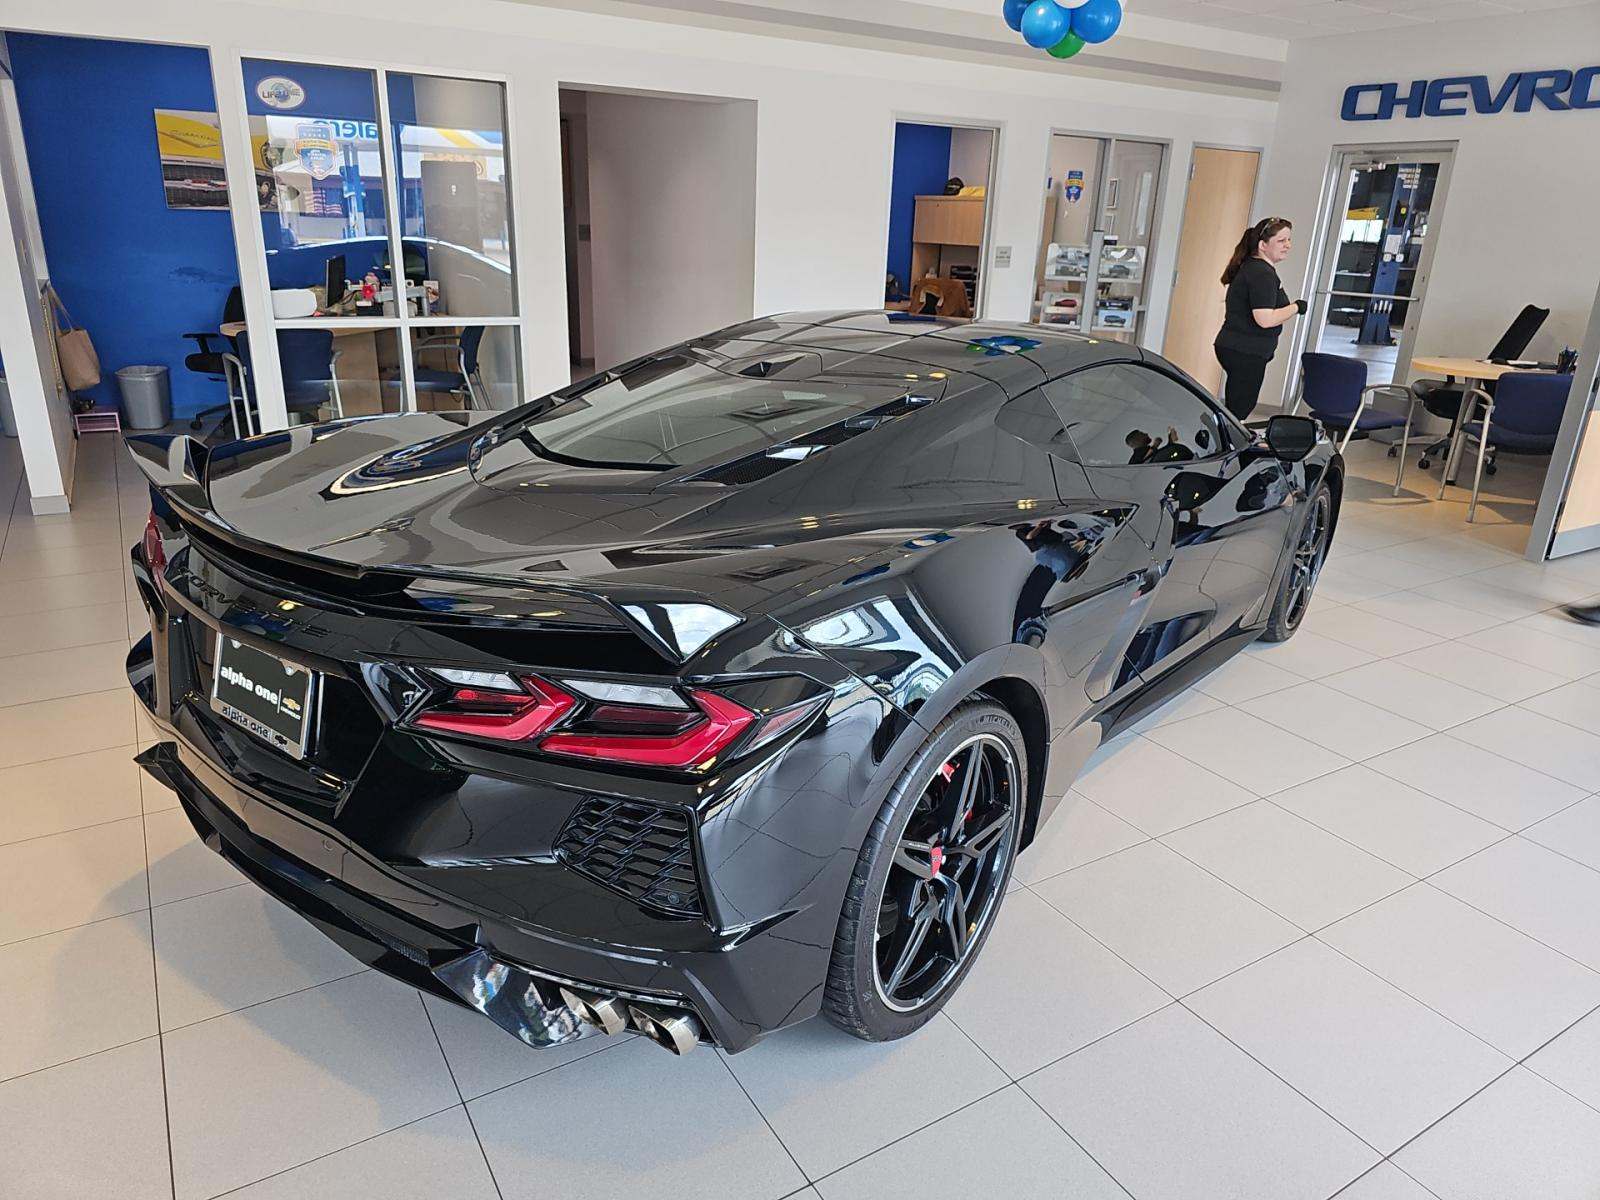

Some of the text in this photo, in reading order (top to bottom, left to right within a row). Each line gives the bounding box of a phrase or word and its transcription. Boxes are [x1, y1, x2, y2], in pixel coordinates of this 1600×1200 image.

[1341, 66, 1600, 121] CHEVRO
[220, 666, 279, 705] alpha one
[222, 705, 272, 738] alpha one
